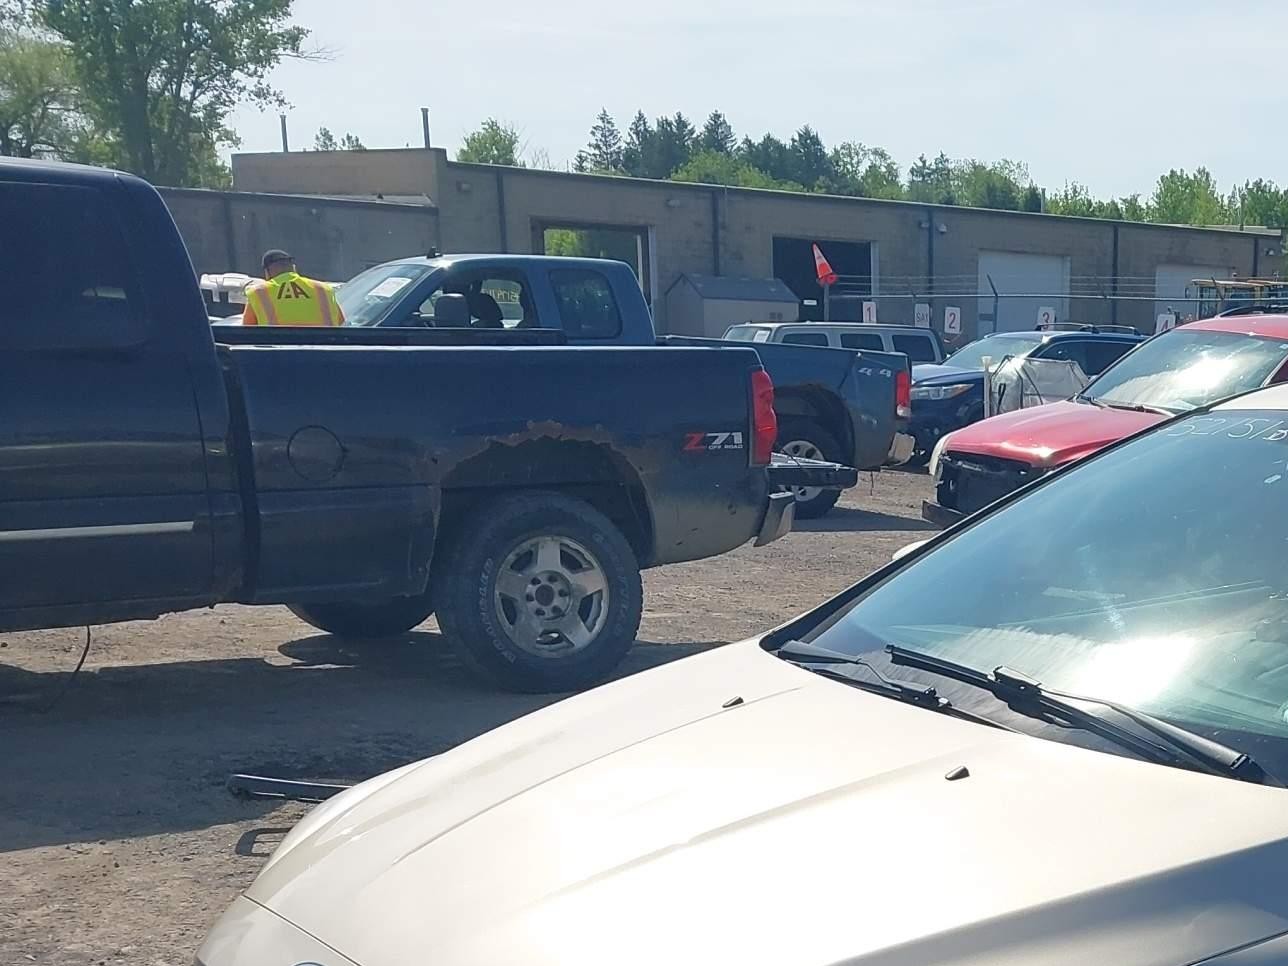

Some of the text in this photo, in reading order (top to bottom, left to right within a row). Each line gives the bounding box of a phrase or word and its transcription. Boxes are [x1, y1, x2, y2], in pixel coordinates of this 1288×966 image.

[277, 281, 310, 299] IAA
[866, 306, 873, 323] 1
[948, 312, 957, 329] 2
[1042, 311, 1050, 330] 3
[682, 431, 743, 453] Z71
